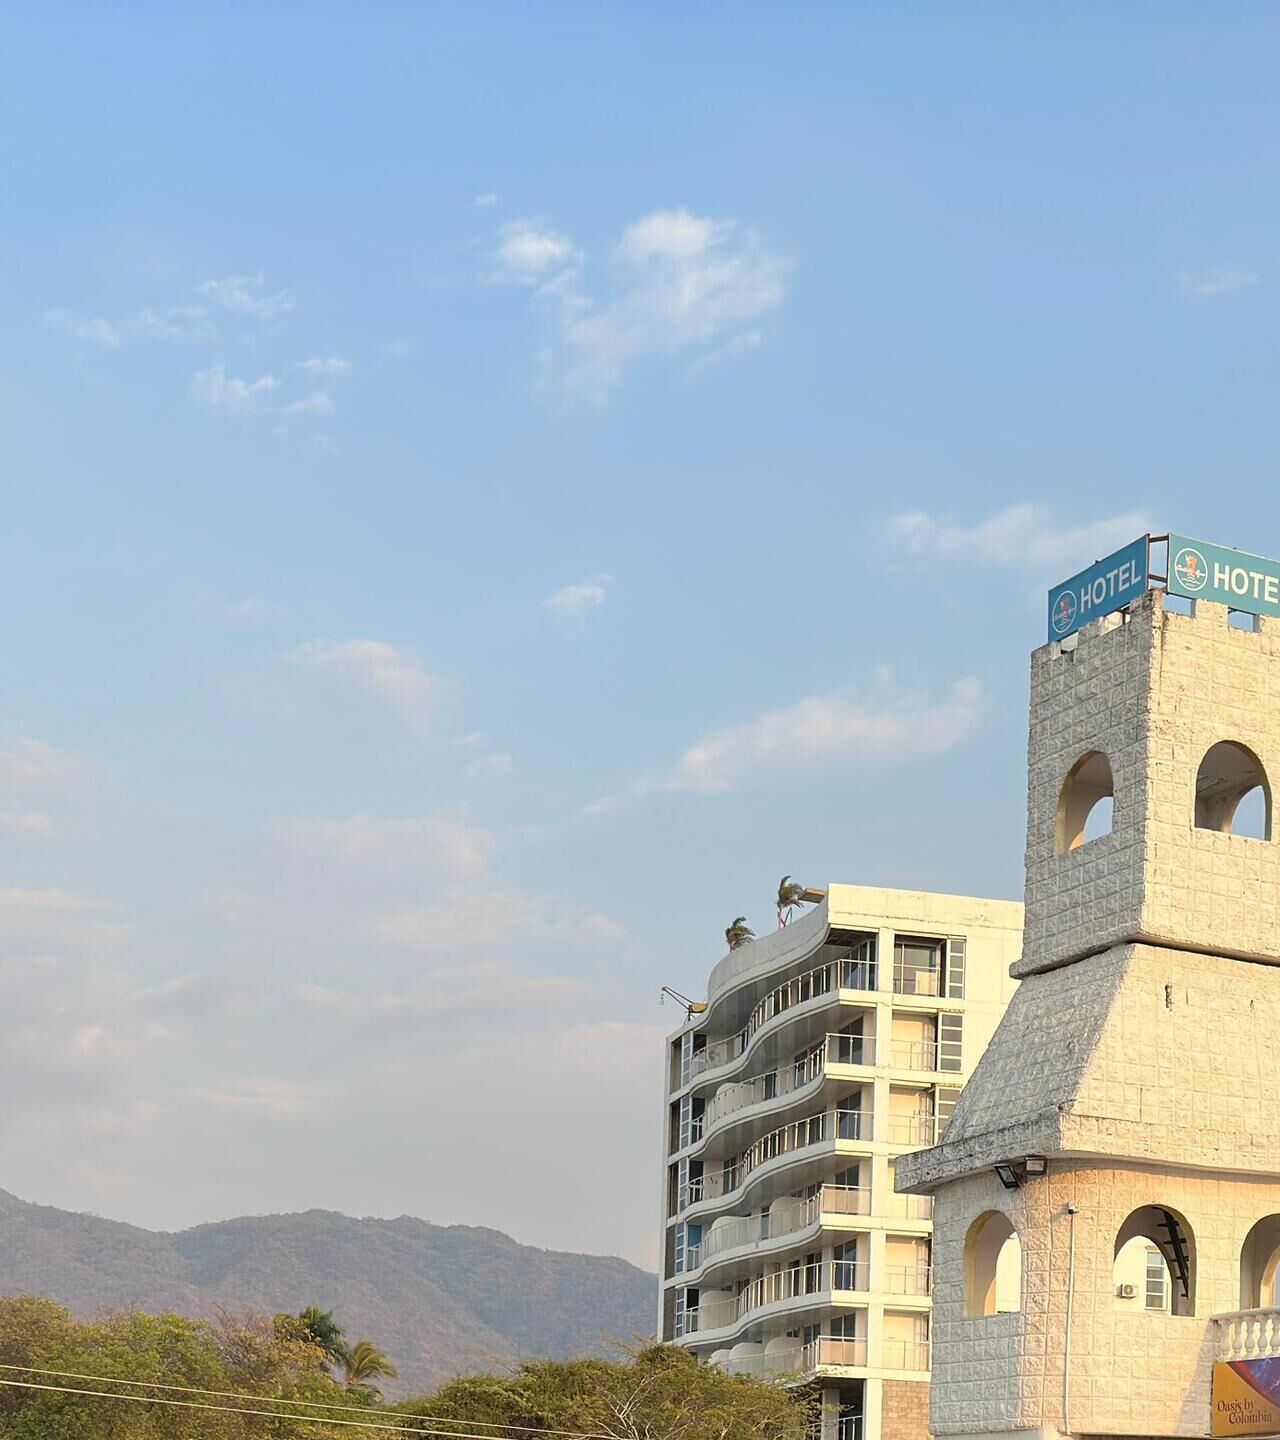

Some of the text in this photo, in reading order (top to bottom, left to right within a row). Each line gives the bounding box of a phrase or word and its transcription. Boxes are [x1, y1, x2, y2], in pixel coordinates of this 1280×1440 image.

[1080, 559, 1142, 613] HOTEL
[1217, 1398, 1255, 1414] Oasis by
[1228, 1410, 1273, 1425] Colombia
